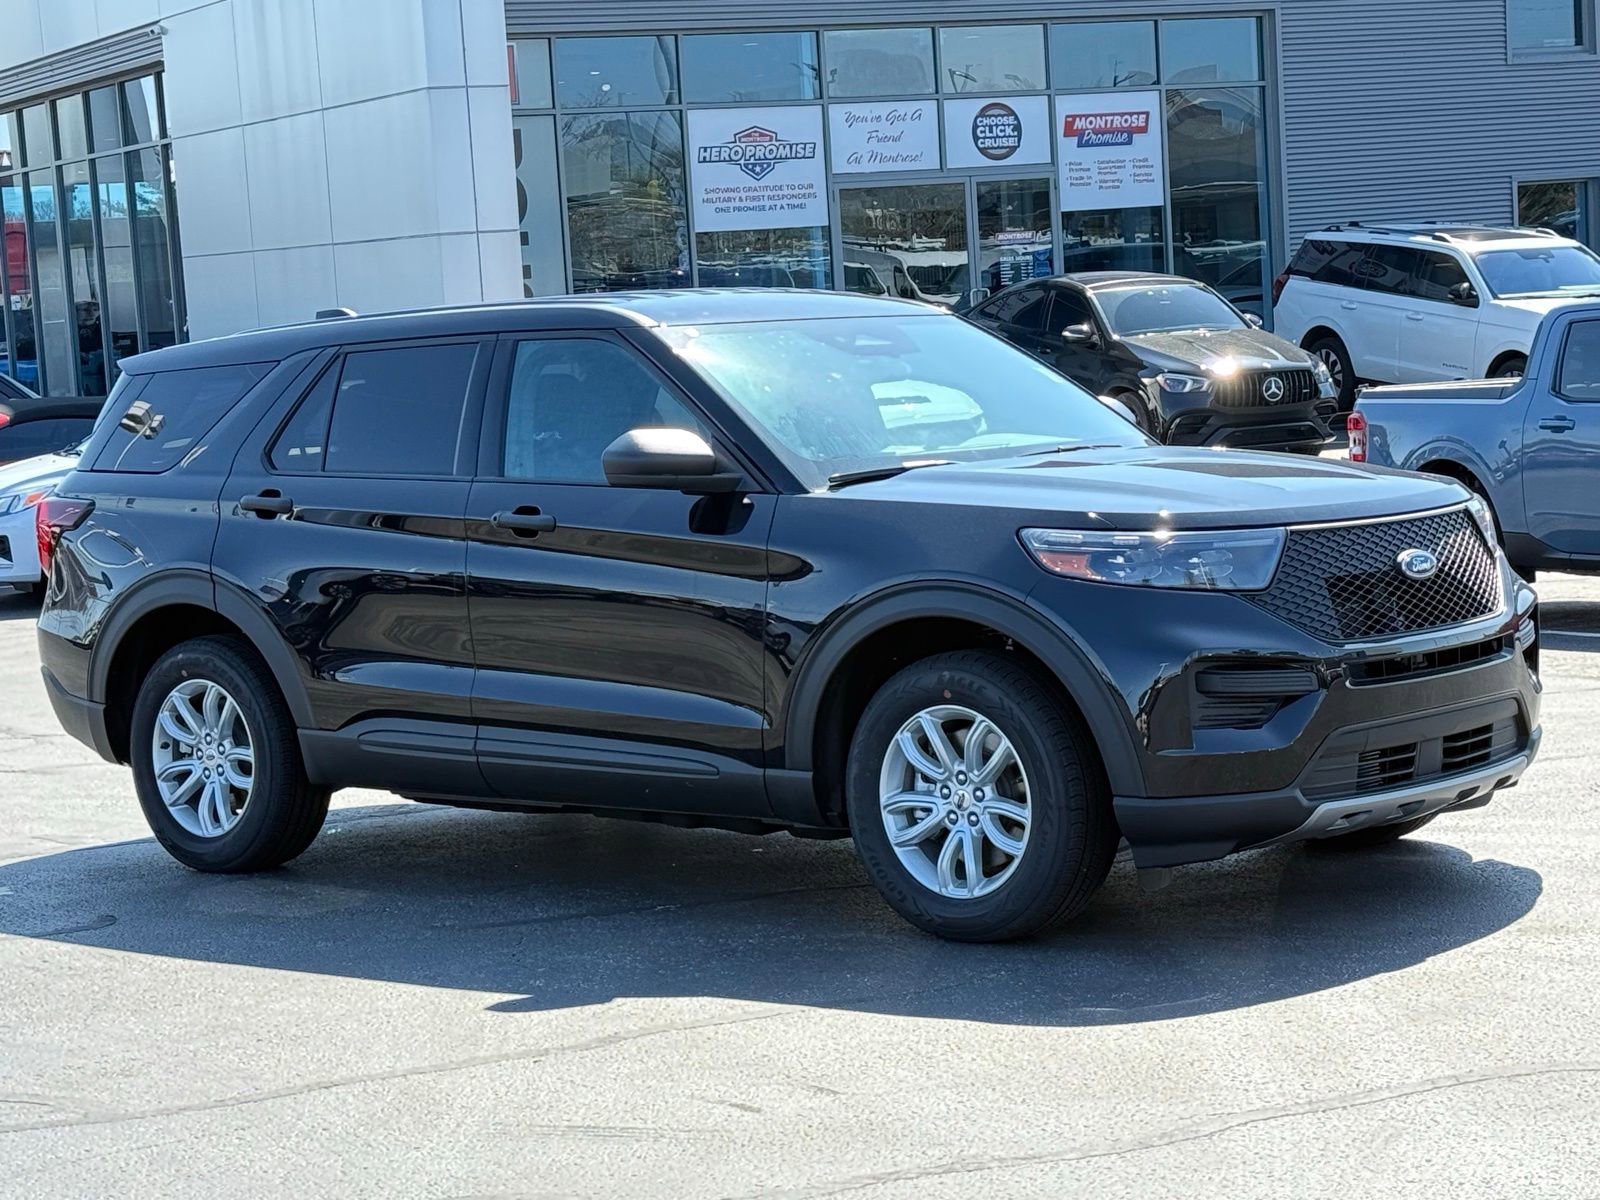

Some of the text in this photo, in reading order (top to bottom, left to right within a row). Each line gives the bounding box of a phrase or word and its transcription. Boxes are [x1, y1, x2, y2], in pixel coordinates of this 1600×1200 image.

[844, 108, 923, 128] You've Got A
[1073, 114, 1147, 130] MONTROSE
[866, 129, 904, 144] Friend
[976, 125, 1018, 138] CLICK.
[1082, 129, 1129, 144] Promise
[977, 136, 1019, 149] CRUISE!
[698, 142, 816, 163] HERO PROMISE
[847, 149, 924, 165] At Montrose!
[704, 186, 742, 195] SHOWING
[742, 184, 785, 193] GRATITUDE
[797, 183, 814, 191] OUR
[702, 192, 818, 204] MILITARY & FIRST RESPONDERS
[714, 206, 732, 214] ONE
[732, 204, 767, 213] PROMISE
[779, 203, 785, 211] A
[786, 202, 807, 210] TIME!
[1412, 557, 1431, 572] Ford
